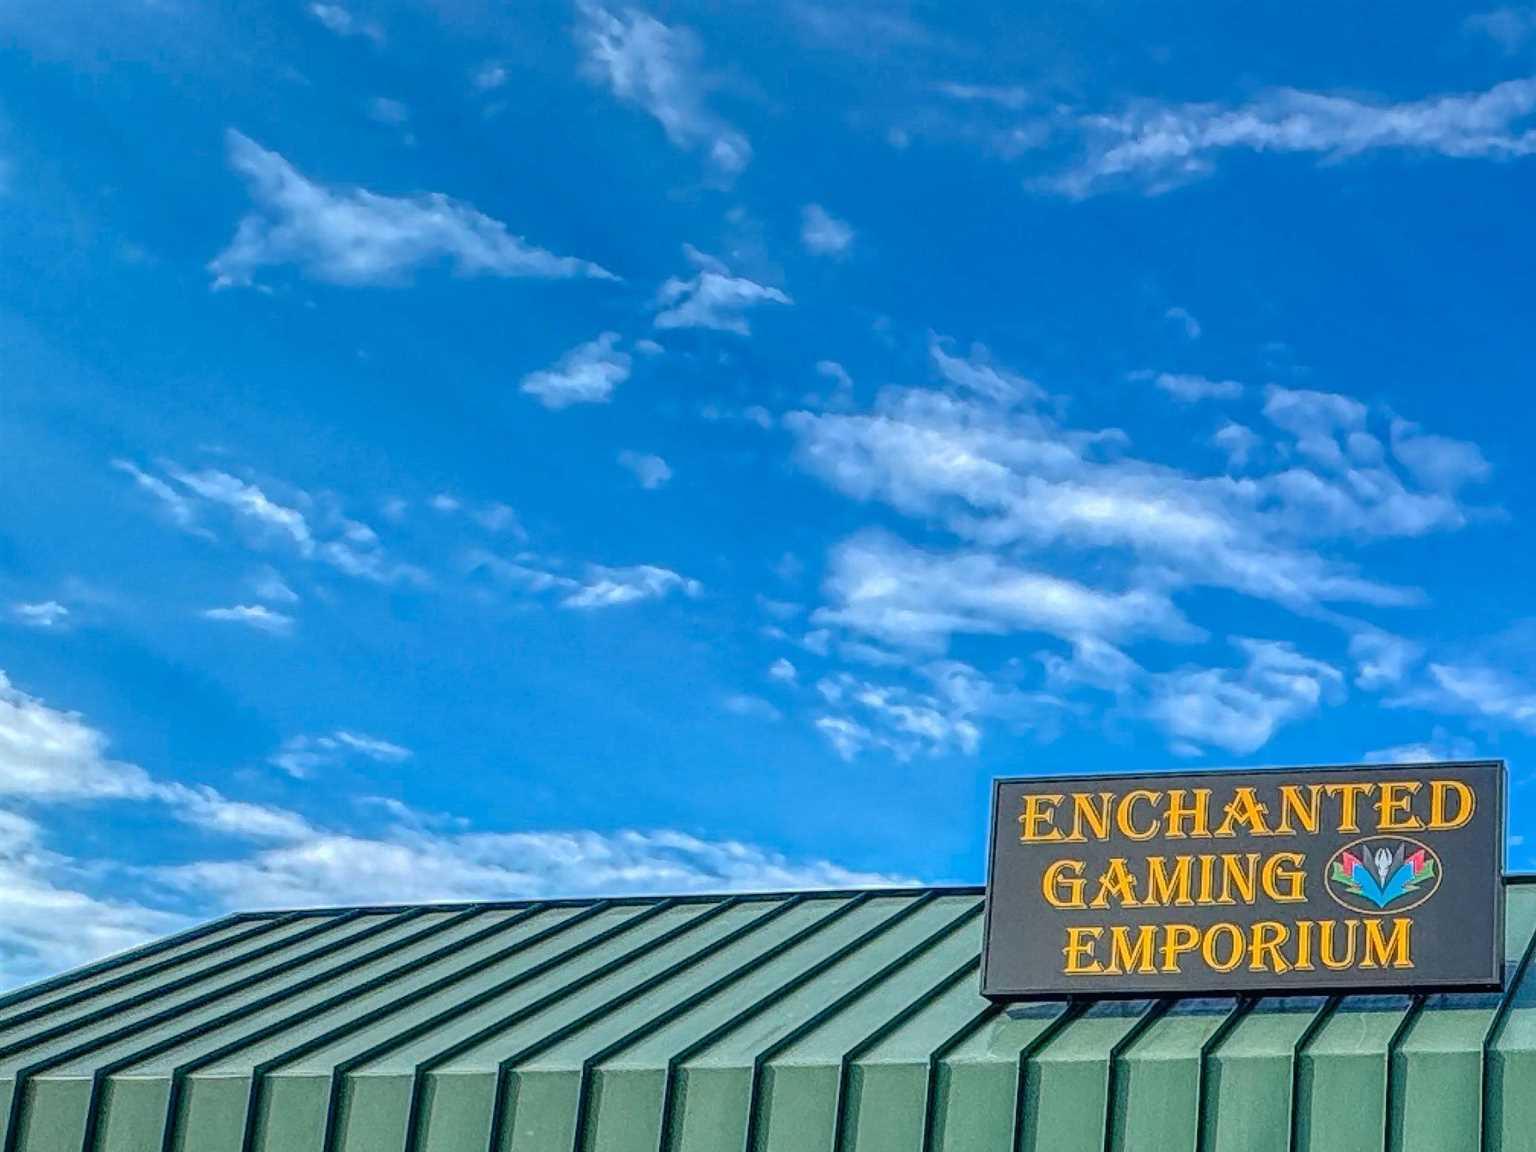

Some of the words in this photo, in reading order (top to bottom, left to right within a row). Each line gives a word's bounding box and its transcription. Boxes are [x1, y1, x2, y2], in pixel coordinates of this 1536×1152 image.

[1018, 778, 1477, 844] ENCHANTED
[1041, 852, 1309, 910] GAMING
[1062, 917, 1415, 976] EMPORIUM
